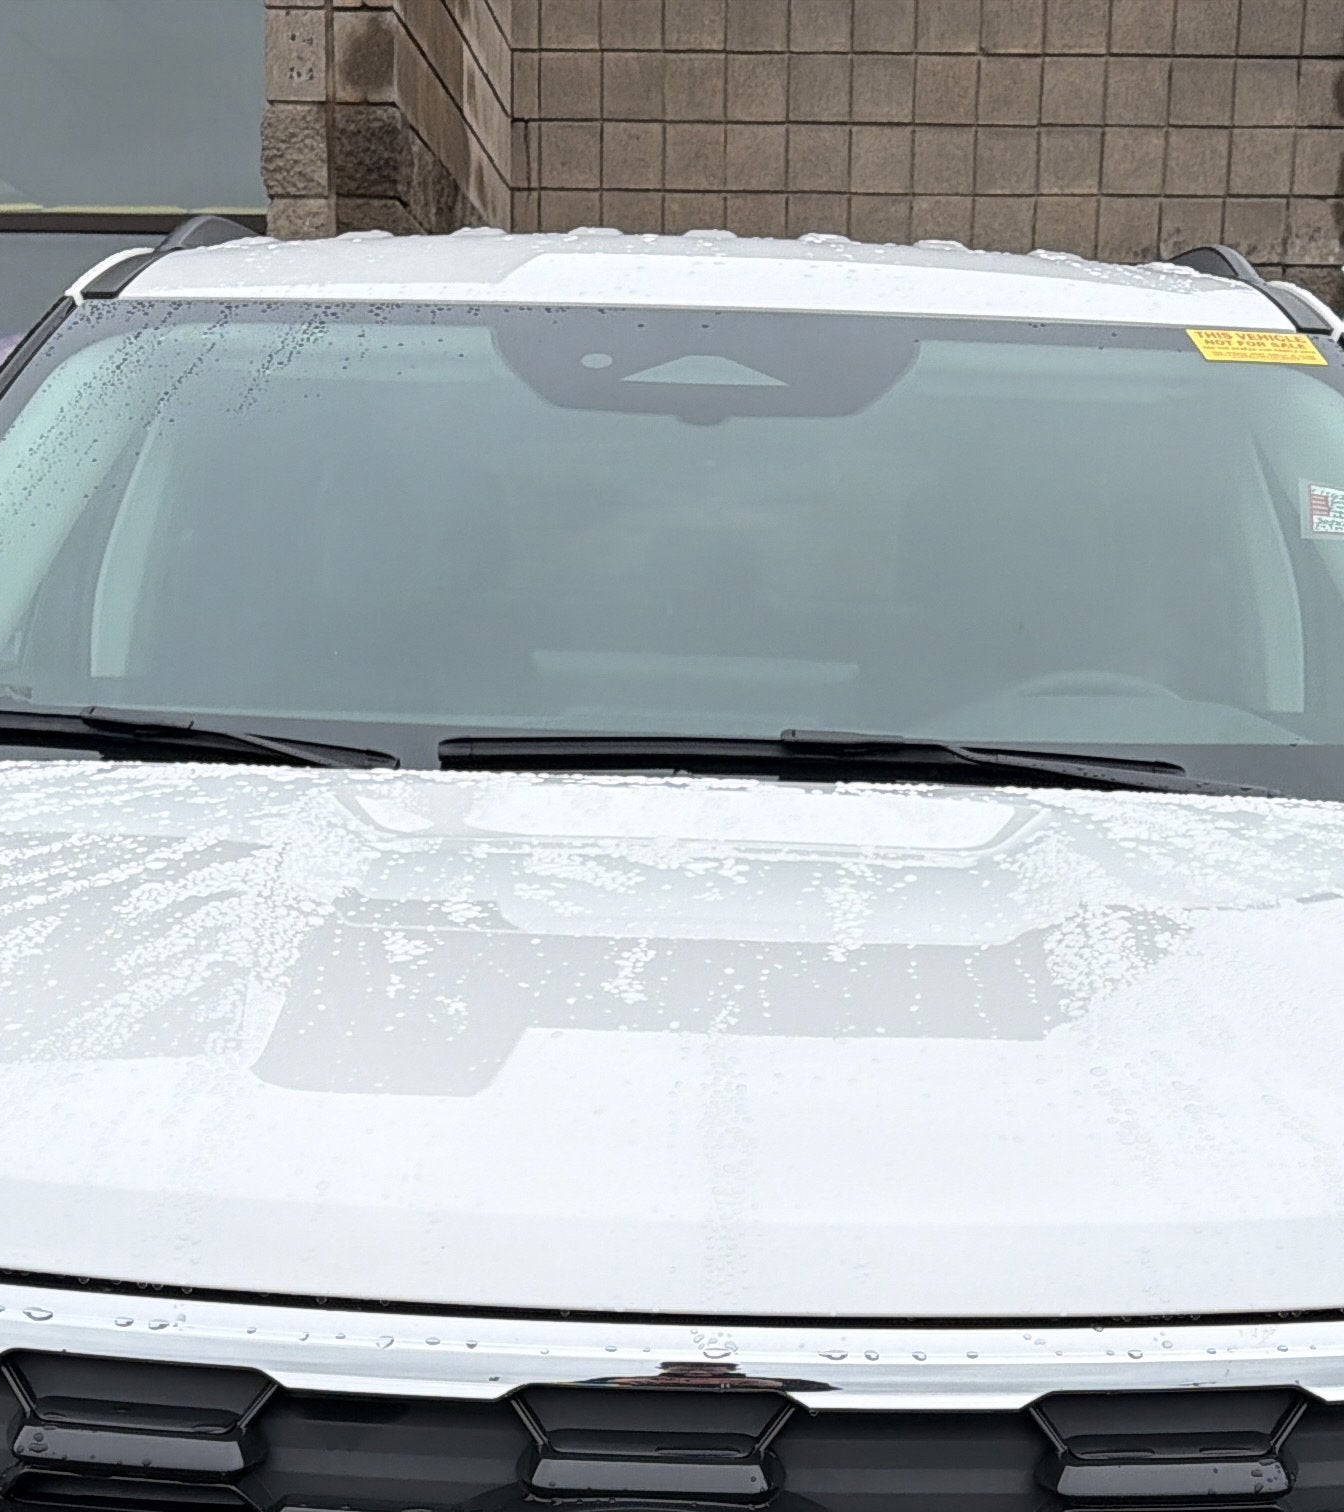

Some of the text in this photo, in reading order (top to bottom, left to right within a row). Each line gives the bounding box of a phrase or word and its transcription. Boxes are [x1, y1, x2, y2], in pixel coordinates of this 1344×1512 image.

[1196, 331, 1307, 343] THIS VEHICLE
[1271, 341, 1307, 349] SALE
